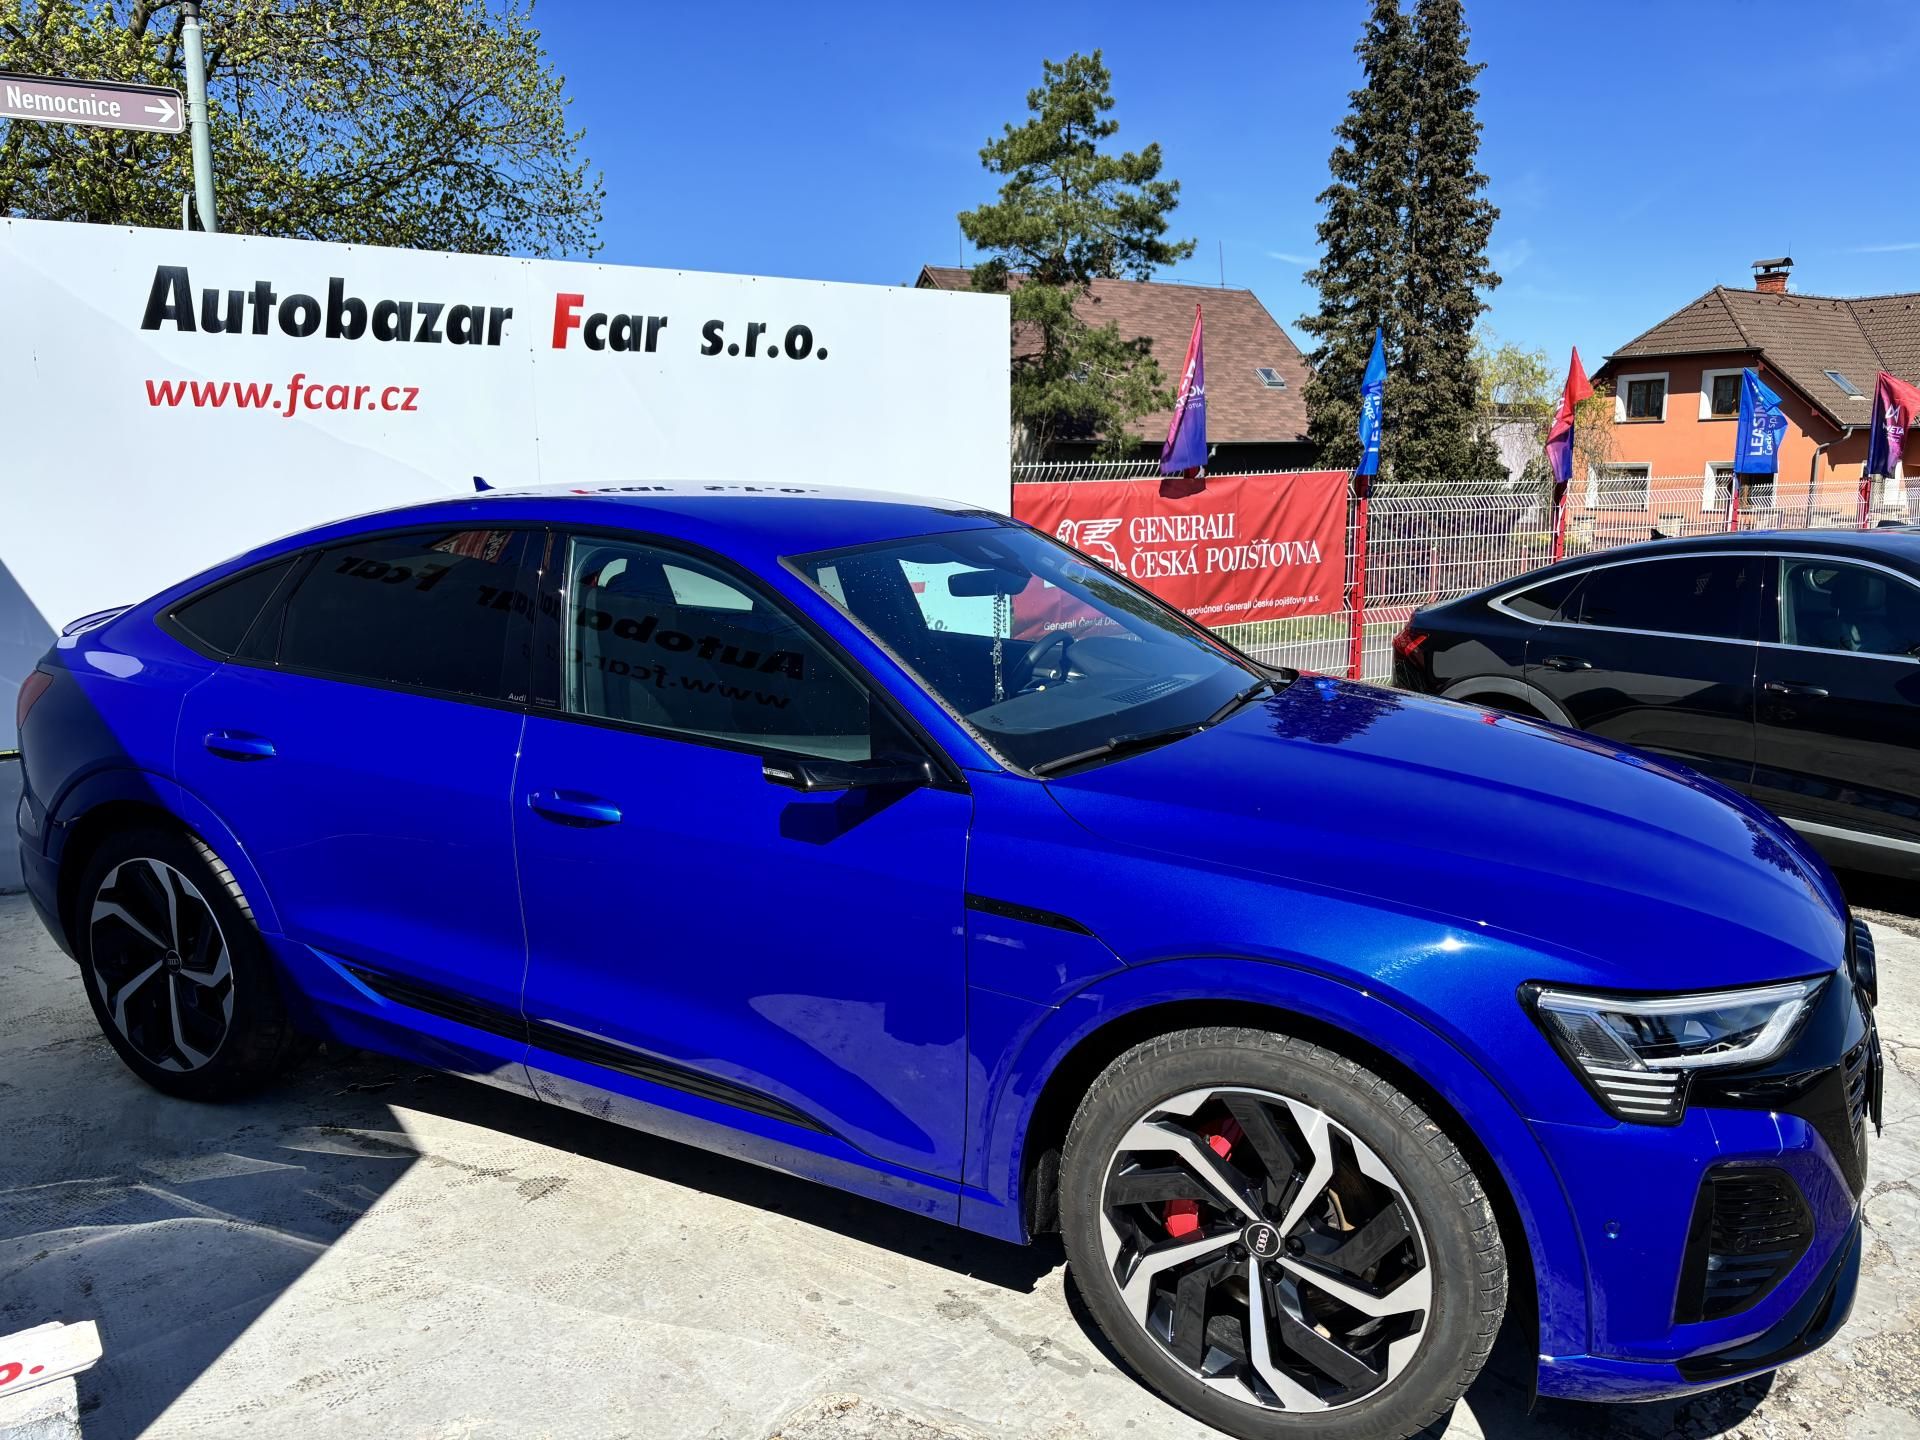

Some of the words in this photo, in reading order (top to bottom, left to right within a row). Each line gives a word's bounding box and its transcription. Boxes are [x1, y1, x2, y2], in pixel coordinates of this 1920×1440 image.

[6, 84, 121, 119] Nemocnice
[140, 264, 513, 346] Autobazar
[552, 292, 668, 353] Fcar
[700, 319, 828, 361] s.r.o.
[145, 373, 419, 418] www.fcar.cz
[1749, 401, 1767, 456] LEASIN
[1130, 513, 1235, 543] GENERALI
[1131, 543, 1198, 578] ČESKÁ
[1206, 539, 1322, 574] POJIŠŤOVNA
[507, 692, 527, 702] Audi
